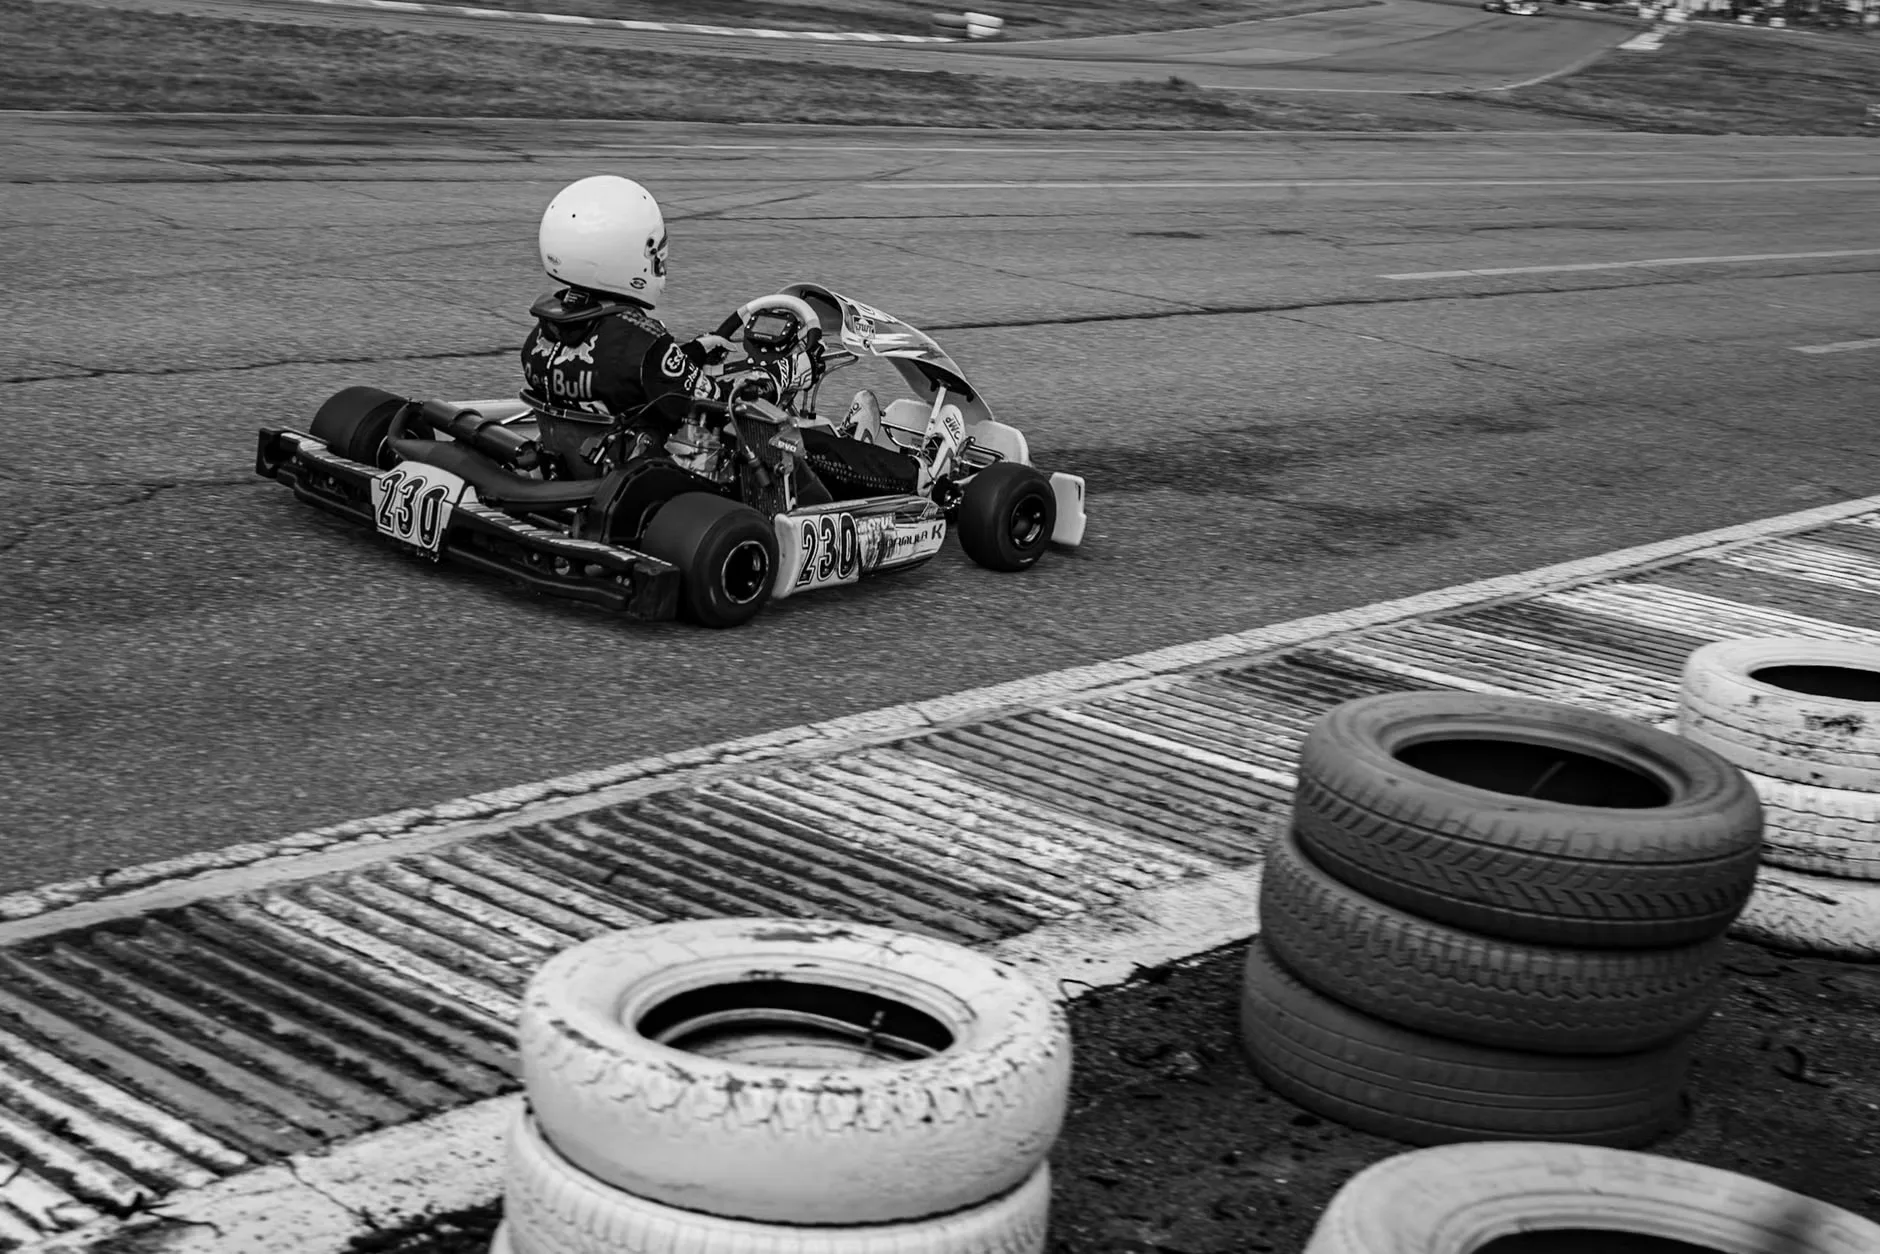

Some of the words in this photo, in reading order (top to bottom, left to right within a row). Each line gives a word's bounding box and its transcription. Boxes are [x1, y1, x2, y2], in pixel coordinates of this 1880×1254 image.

[553, 368, 593, 399] Bull
[378, 469, 450, 549] 230
[931, 523, 944, 540] K
[797, 512, 858, 585] 230
